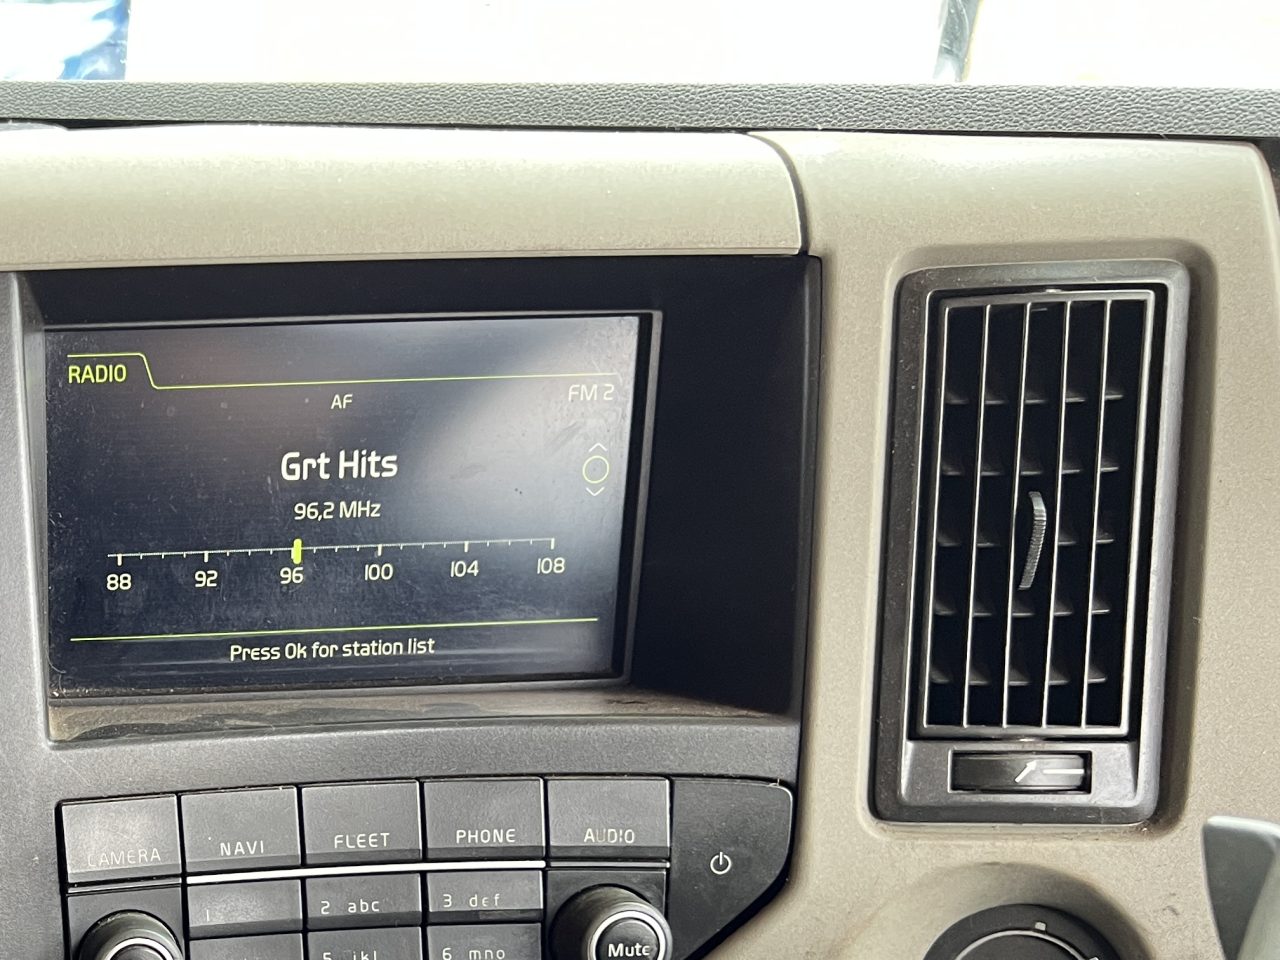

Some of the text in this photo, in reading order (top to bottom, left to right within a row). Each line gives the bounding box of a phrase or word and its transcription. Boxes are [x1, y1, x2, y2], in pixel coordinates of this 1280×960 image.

[69, 364, 126, 383] RADIO
[568, 384, 614, 401] FM 2
[331, 394, 352, 409] AF
[281, 450, 397, 480] Grt Hits
[340, 500, 380, 518] MHz
[107, 557, 565, 590] 88 92 96 100 104 108
[231, 638, 435, 661] Press Ok for station list
[335, 833, 389, 848] FLEET
[456, 829, 515, 846] PHONE
[583, 828, 635, 844] AUDIO
[220, 840, 263, 856] NAVI
[88, 848, 162, 868] CAMERA
[321, 899, 379, 914] 2 abc
[443, 894, 503, 909] 3 def
[443, 948, 505, 960] 6 mno
[608, 943, 649, 957] Mute
